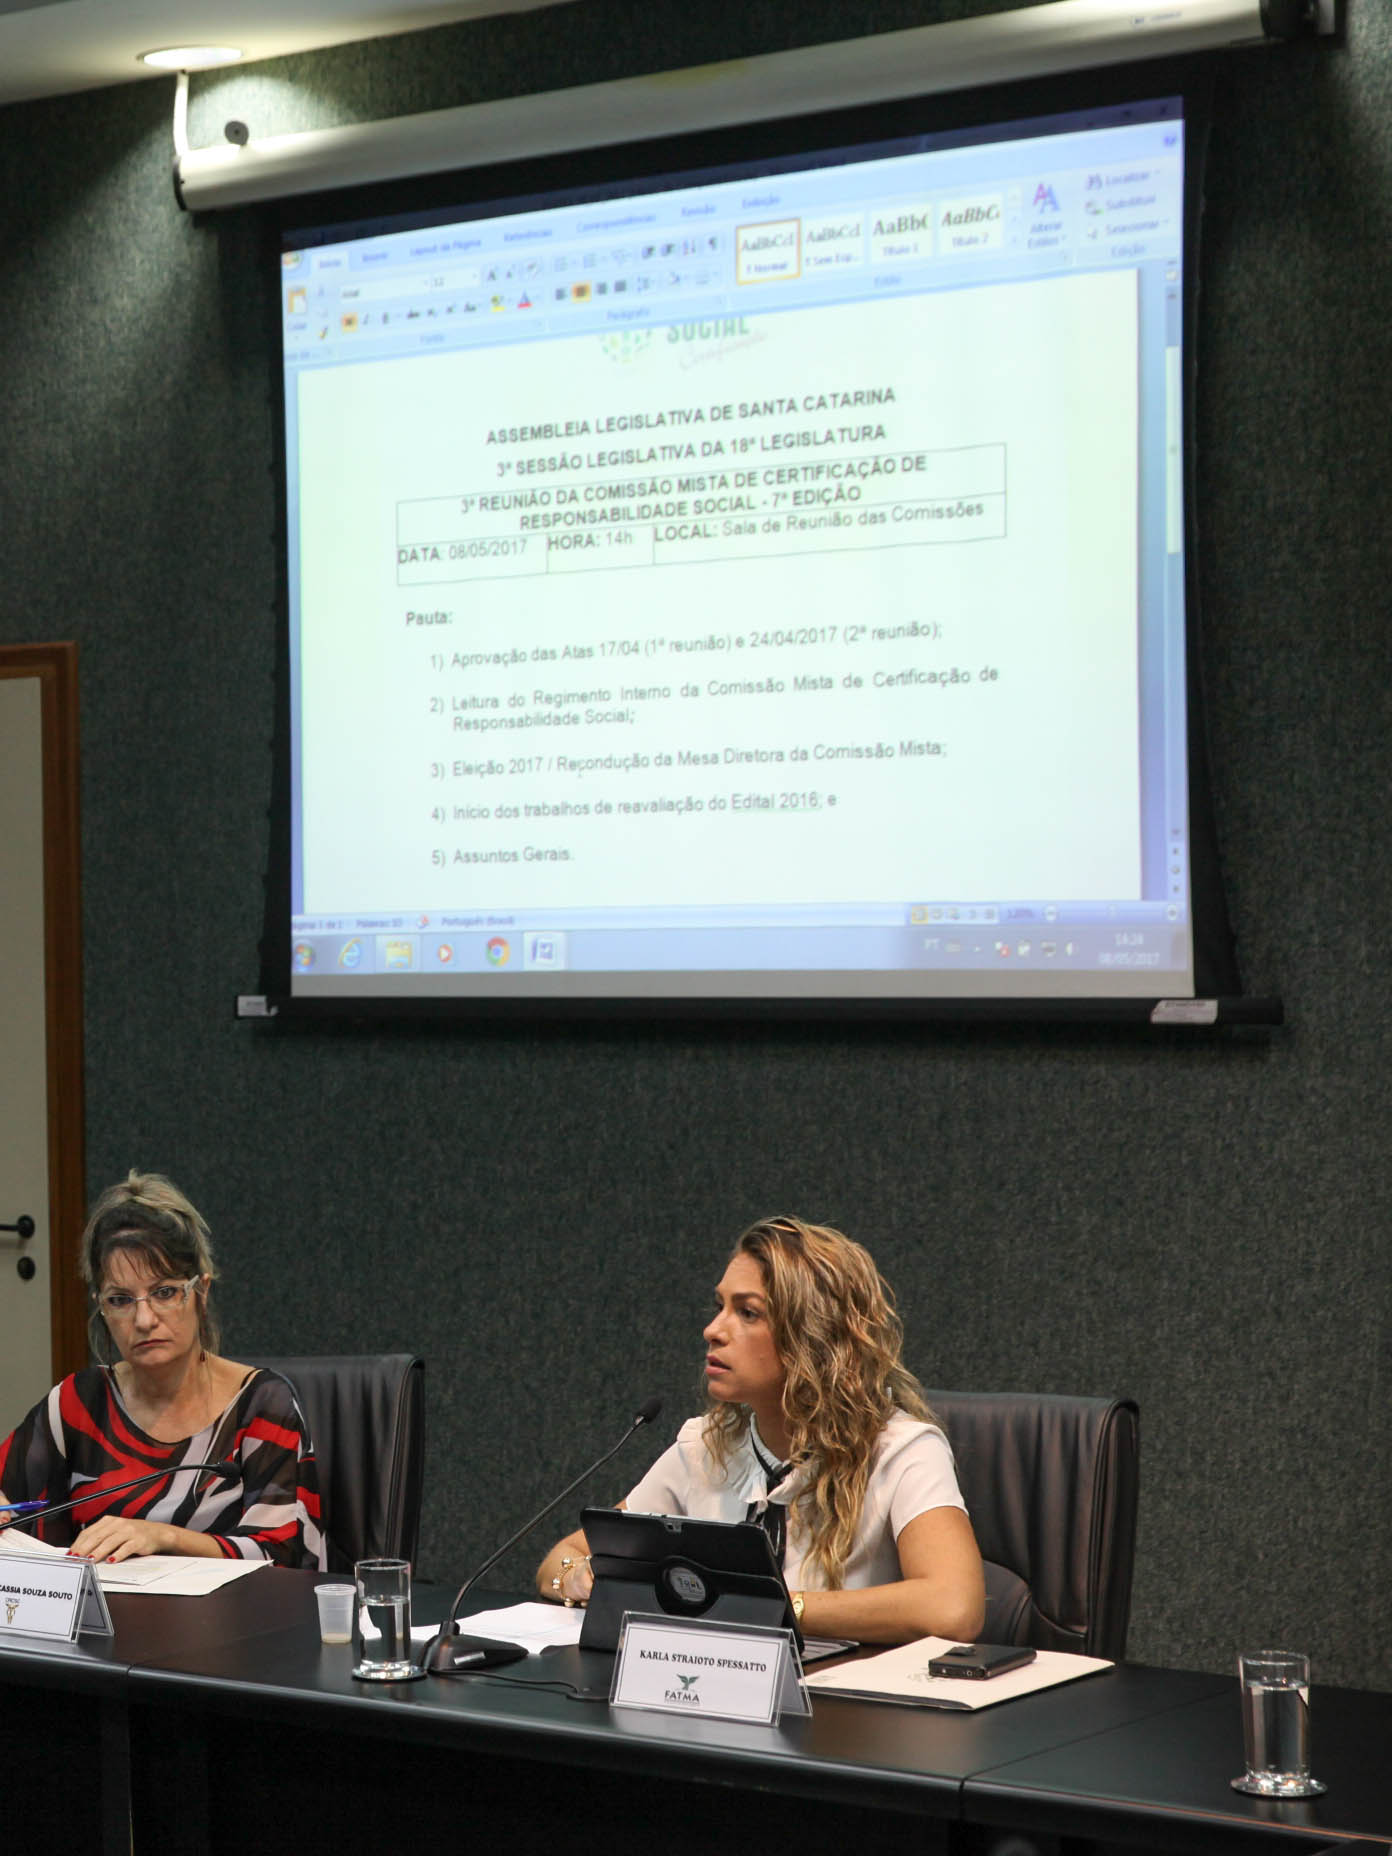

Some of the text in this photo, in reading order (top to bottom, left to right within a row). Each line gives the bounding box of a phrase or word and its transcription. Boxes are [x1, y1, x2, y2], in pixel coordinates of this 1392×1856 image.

[486, 387, 896, 445] ASSEMBLEIA LEGISLATIVA DE SANTA CATARINA
[516, 453, 583, 476] SESSÃO
[587, 443, 696, 469] LEGISLATIVA
[701, 441, 725, 458] DA
[761, 424, 887, 451] LEGISLATURA
[479, 488, 551, 512] REUNIÃO
[557, 488, 580, 505] DA
[584, 478, 672, 502] COMISSÃO
[678, 474, 729, 494] MISTA
[735, 470, 758, 488] DE
[763, 456, 896, 487] CERTIFICAÇÃO
[901, 454, 927, 472] DE
[520, 500, 688, 530] RESPONSABILIDADE
[693, 495, 756, 515] SOCIAL
[792, 484, 862, 507] EDIÇÃO
[762, 516, 781, 534] de
[786, 510, 853, 532] Reunião
[858, 507, 887, 526] das
[892, 500, 985, 523] Comissões
[606, 529, 633, 546] 14h
[451, 648, 528, 670] Aprovação
[531, 646, 558, 662] das
[561, 643, 595, 660] Atas
[600, 640, 640, 657] 17/04
[735, 637, 746, 649] e
[749, 626, 838, 648] 24/04/2017
[452, 694, 499, 712] Leitura
[507, 692, 526, 708] do
[533, 688, 612, 709] Regimento
[620, 685, 671, 702] Interno
[680, 681, 700, 698] da
[707, 677, 785, 697] Comissão
[793, 674, 834, 692] Mista
[842, 672, 863, 689] de
[872, 666, 971, 688] Certificação
[979, 665, 999, 683] de
[453, 710, 580, 734] Responsabilidade
[453, 759, 505, 779] Eleição
[509, 756, 544, 775] 2017
[654, 751, 673, 767] da
[677, 750, 719, 767] Mesa
[723, 747, 785, 765] Diretora
[790, 746, 809, 762] da
[813, 742, 895, 761] Comissão
[494, 803, 520, 819] dos
[524, 799, 590, 818] trabalhos
[594, 799, 613, 815] de
[617, 795, 704, 816] reavaliação
[708, 794, 727, 811] do
[731, 791, 775, 809] Edital
[827, 794, 837, 806] e
[453, 847, 519, 865] Assuntos
[22, 1587, 47, 1597] SOUZA
[48, 1590, 73, 1601] SOUTO
[639, 1650, 767, 1672] KARLA STRAIOTO SPESSATTO
[664, 1689, 700, 1702] FATMA
